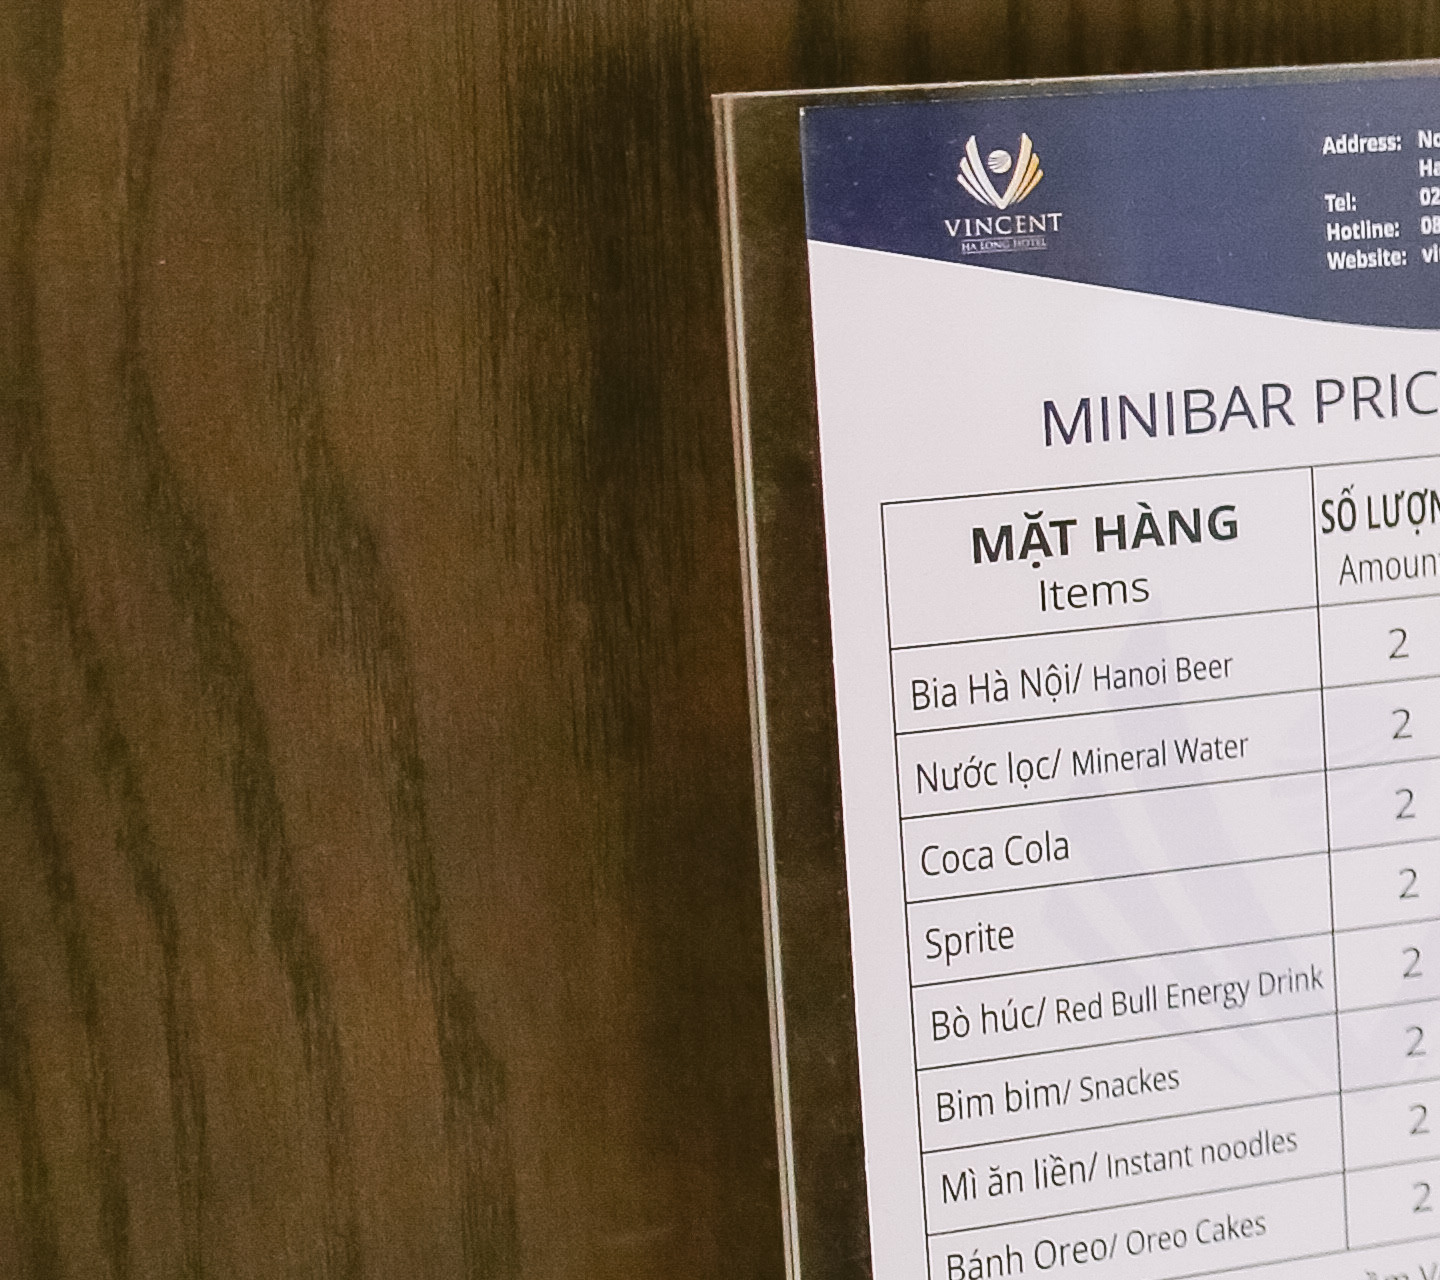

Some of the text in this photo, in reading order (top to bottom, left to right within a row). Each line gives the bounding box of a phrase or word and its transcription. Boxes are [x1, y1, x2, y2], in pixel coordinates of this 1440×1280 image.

[1323, 134, 1401, 155] Address:
[1325, 193, 1356, 213] Tel:
[945, 213, 1062, 237] VINCENT
[1327, 221, 1399, 241] Hotline:
[1327, 250, 1407, 270] Website:
[1043, 384, 1295, 446] MINIBAR
[1321, 484, 1357, 534] SỐ
[972, 502, 1238, 568] MẶT HÀNG
[1041, 577, 1150, 612] Items
[1389, 628, 1409, 659] 2
[912, 655, 1233, 711] Bia Hà Nội/ Hanoi Beer
[1392, 709, 1412, 739] 2
[917, 735, 1249, 793] Nước lọc/ Mineral Water
[1395, 789, 1415, 819] 2
[921, 830, 1069, 876] Coca Cola
[1399, 868, 1419, 899] 2
[926, 922, 1015, 965] Sprite
[1402, 947, 1422, 978] 2
[932, 963, 1325, 1041] Bò húc/ Red Bull Energy Drink
[1405, 1026, 1426, 1056] 2
[937, 1068, 1180, 1122] Bim bim/ Snackes
[1409, 1104, 1429, 1134] 2
[941, 1129, 1298, 1204] Mì ăn liền/ Instant noodles
[1413, 1182, 1432, 1213] 2
[1034, 1233, 1117, 1270] Oreo/
[1126, 1228, 1187, 1255] Oreo
[1196, 1214, 1267, 1245] Cakes
